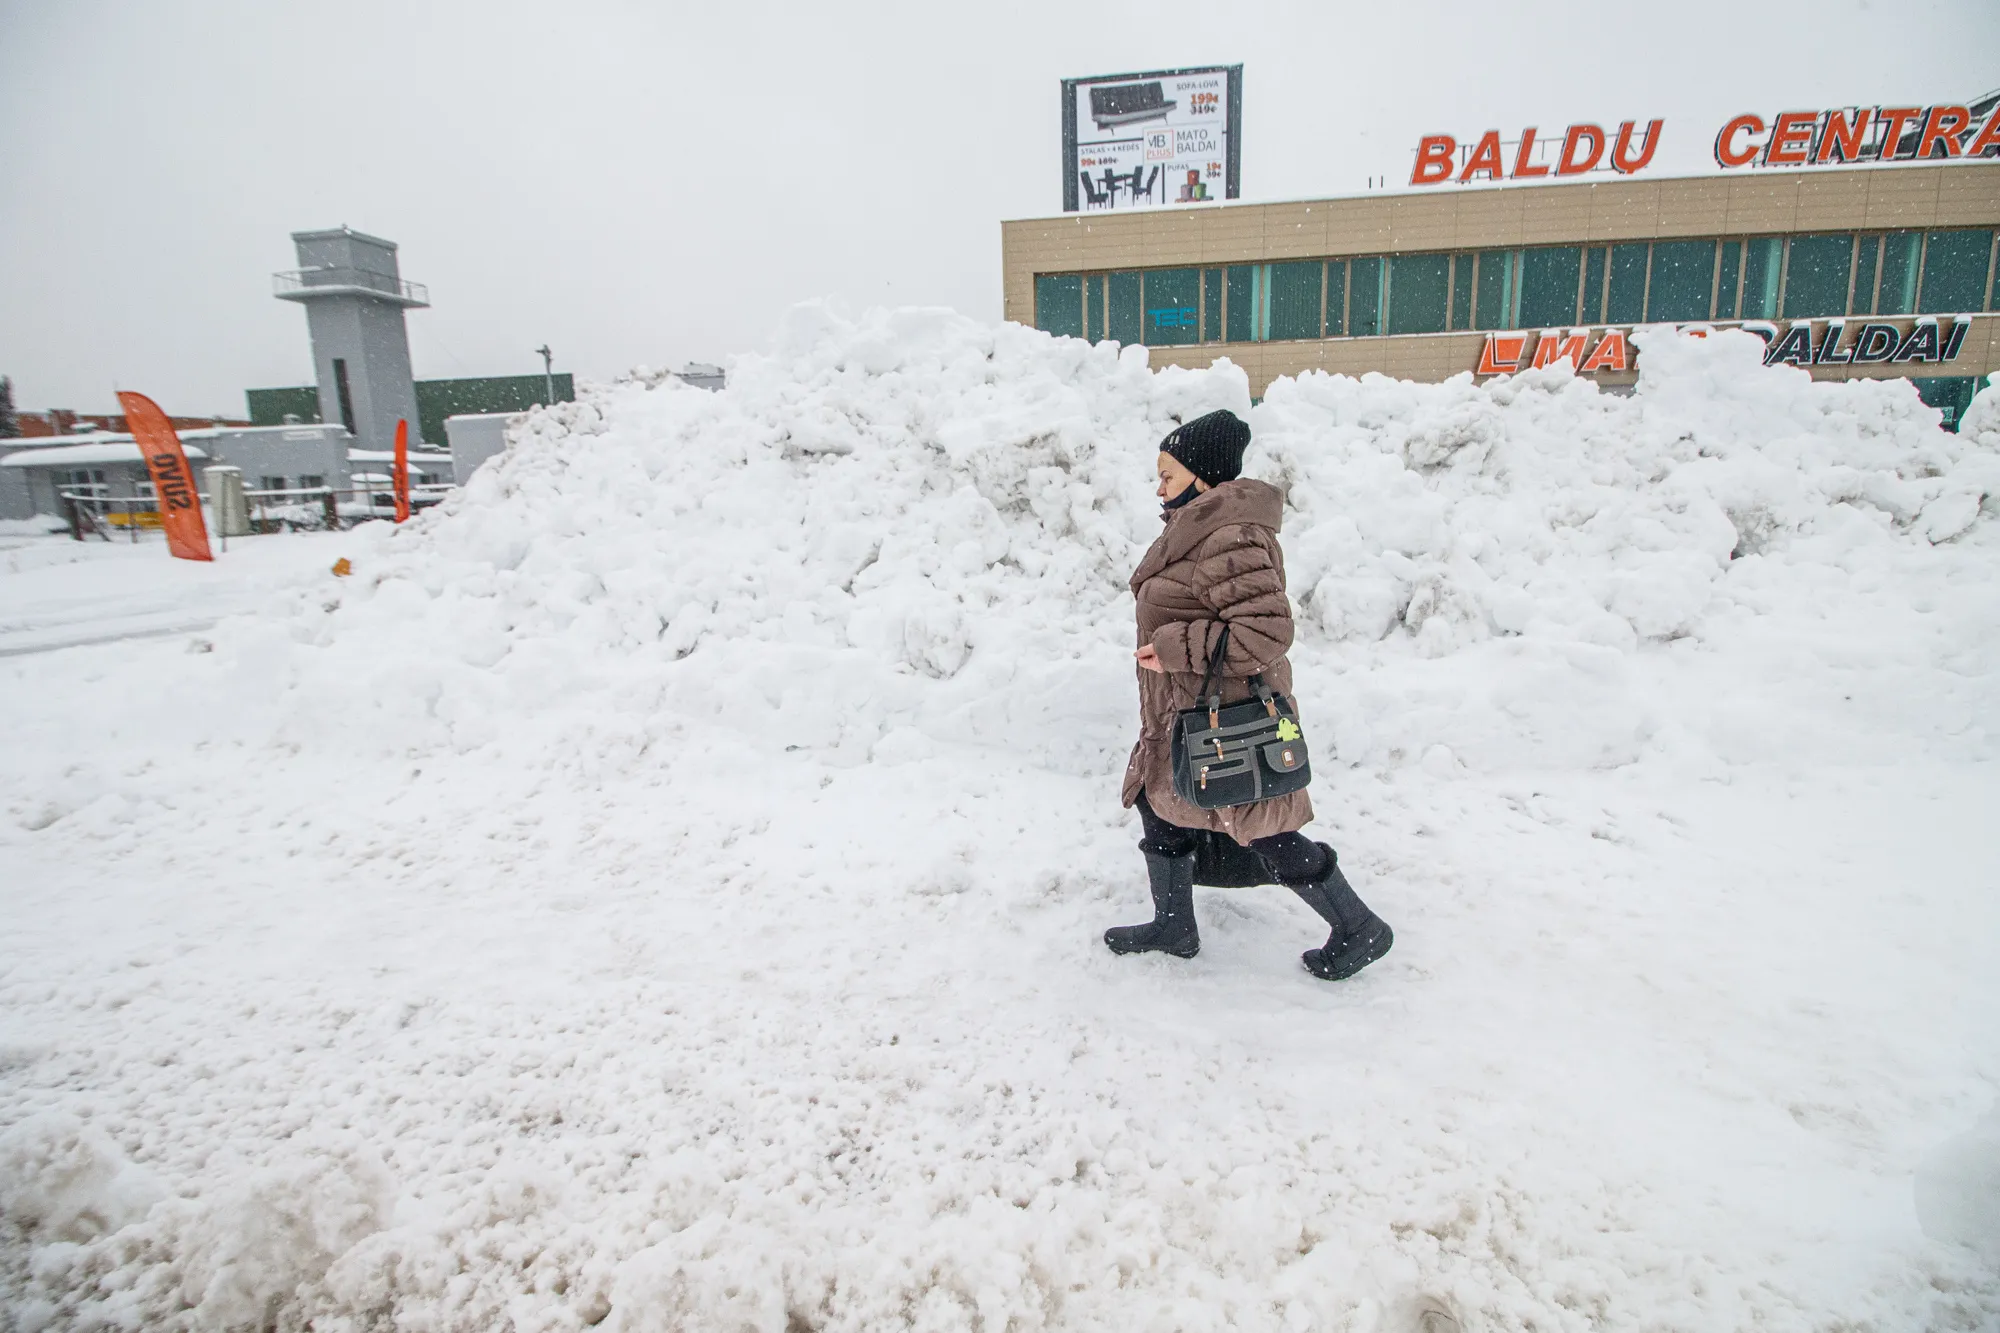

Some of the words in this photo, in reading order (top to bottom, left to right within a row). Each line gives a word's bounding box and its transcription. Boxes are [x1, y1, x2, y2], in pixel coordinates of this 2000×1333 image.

[1176, 129, 1208, 141] MATO
[1176, 140, 1217, 154] BALDAI
[1147, 307, 1197, 327] TEC
